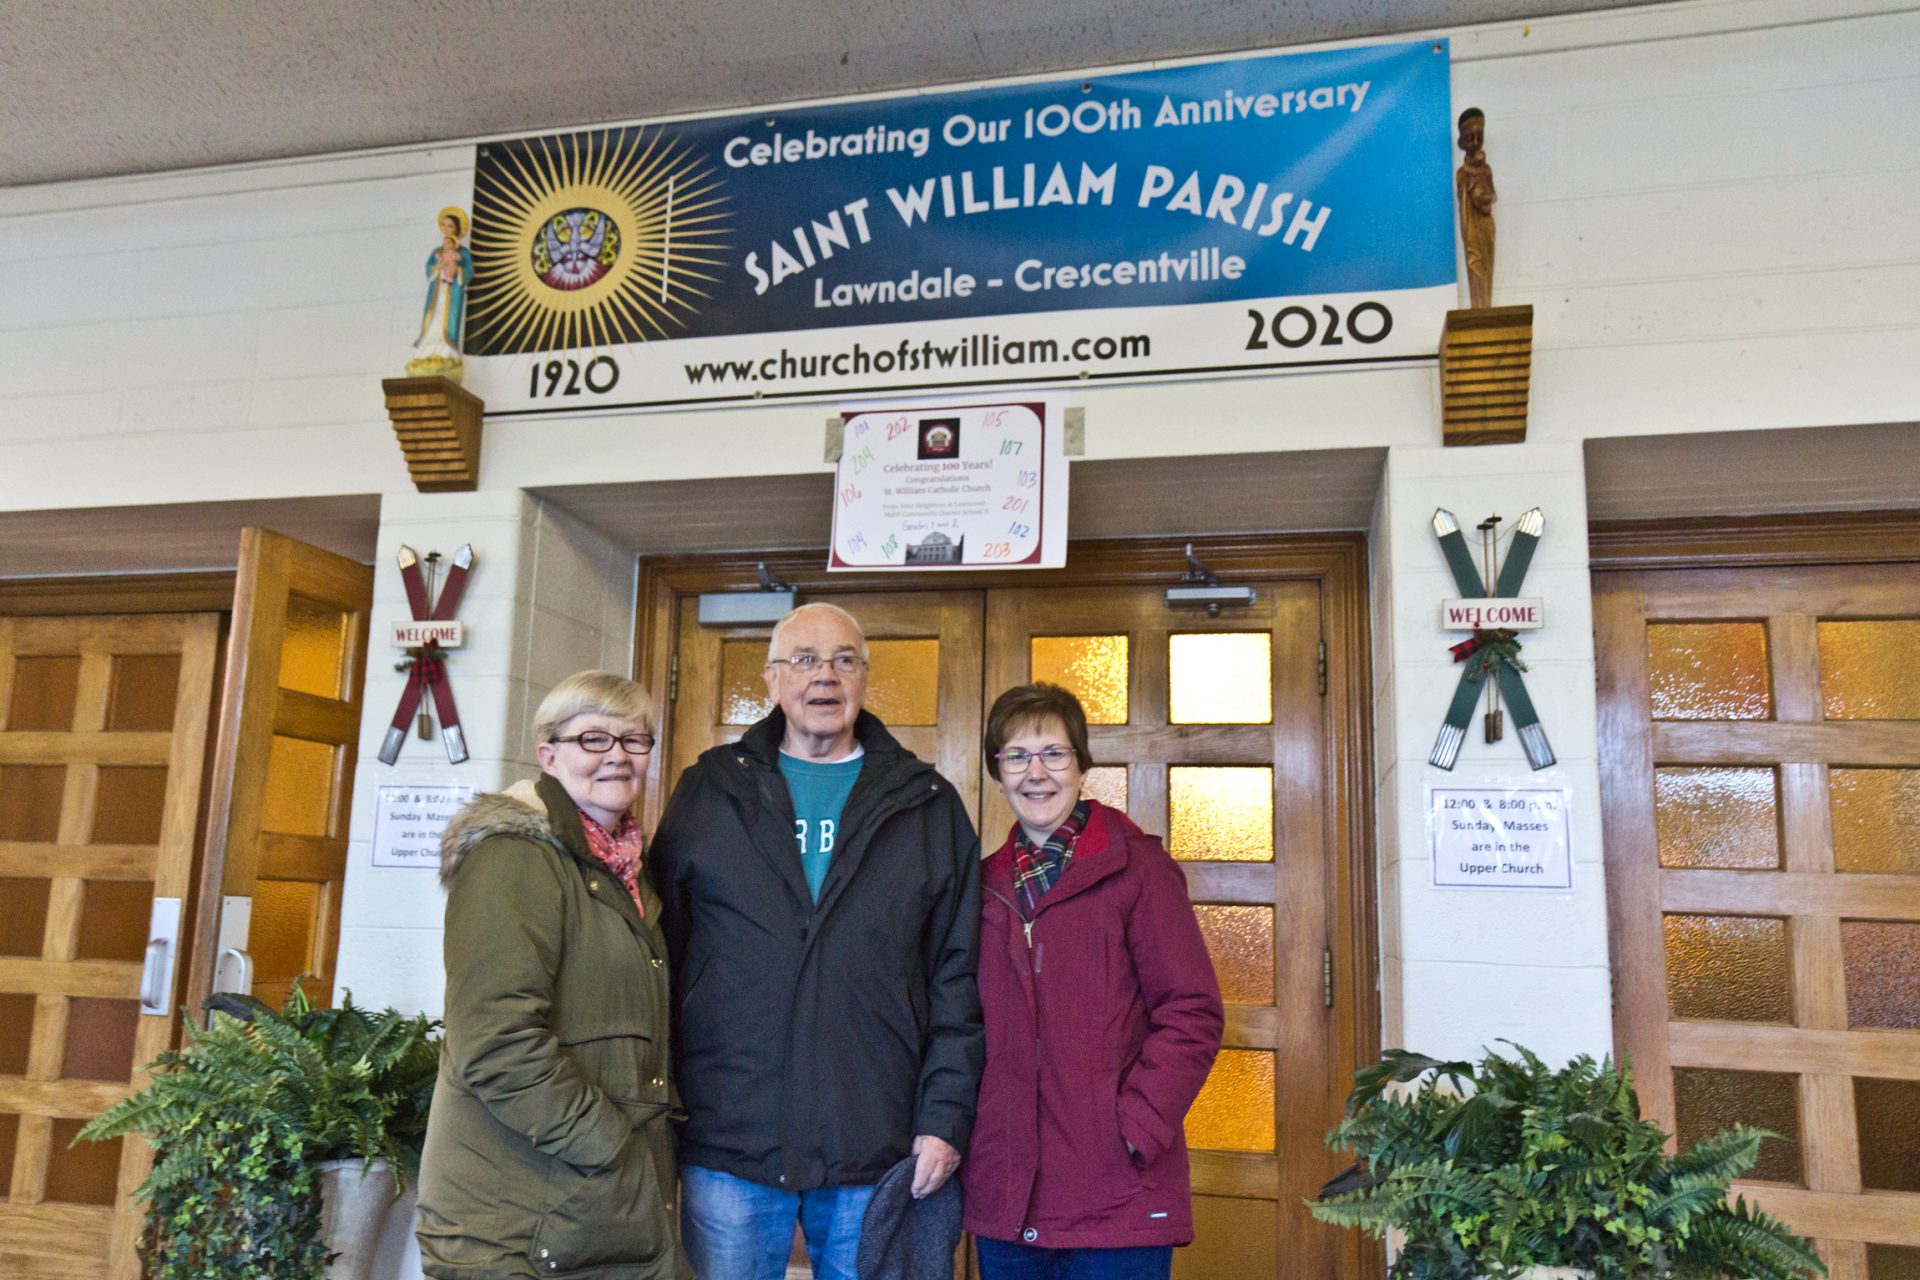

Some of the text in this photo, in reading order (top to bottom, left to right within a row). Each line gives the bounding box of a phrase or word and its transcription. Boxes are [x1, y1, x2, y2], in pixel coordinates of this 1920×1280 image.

[723, 80, 1372, 168] Celebrating Our 100th Anniversary
[744, 161, 1333, 297] SAINT WILLIAM PARISH
[813, 266, 977, 308] Lawndale
[1014, 247, 1247, 293] Crescentville
[1245, 301, 1394, 351] 2020
[685, 331, 1151, 385] www.churchofstwilliam.com
[529, 355, 620, 399] 1920
[886, 416, 912, 441] 202
[1000, 439, 1023, 456] 107
[883, 459, 993, 473] Celebrating 100 Years!
[905, 475, 970, 485] Congratulations
[1016, 469, 1037, 489] 103
[883, 484, 992, 496] St. William Catholic Church
[1002, 495, 1029, 513] 201
[1007, 521, 1030, 538] 102
[881, 533, 899, 559] 108
[983, 542, 1011, 559] 203
[1448, 606, 1539, 624] WELCOME
[395, 627, 457, 642] WELCOME
[1443, 799, 1476, 809] 12:00
[1498, 799, 1526, 810] 8:00
[390, 812, 421, 823] Sunday
[418, 830, 427, 838] in
[429, 831, 443, 839] the
[1451, 820, 1549, 833] Sunday Masses
[391, 848, 418, 858] Upper
[1471, 841, 1531, 852] are in the
[1459, 862, 1544, 875] Upper Church
